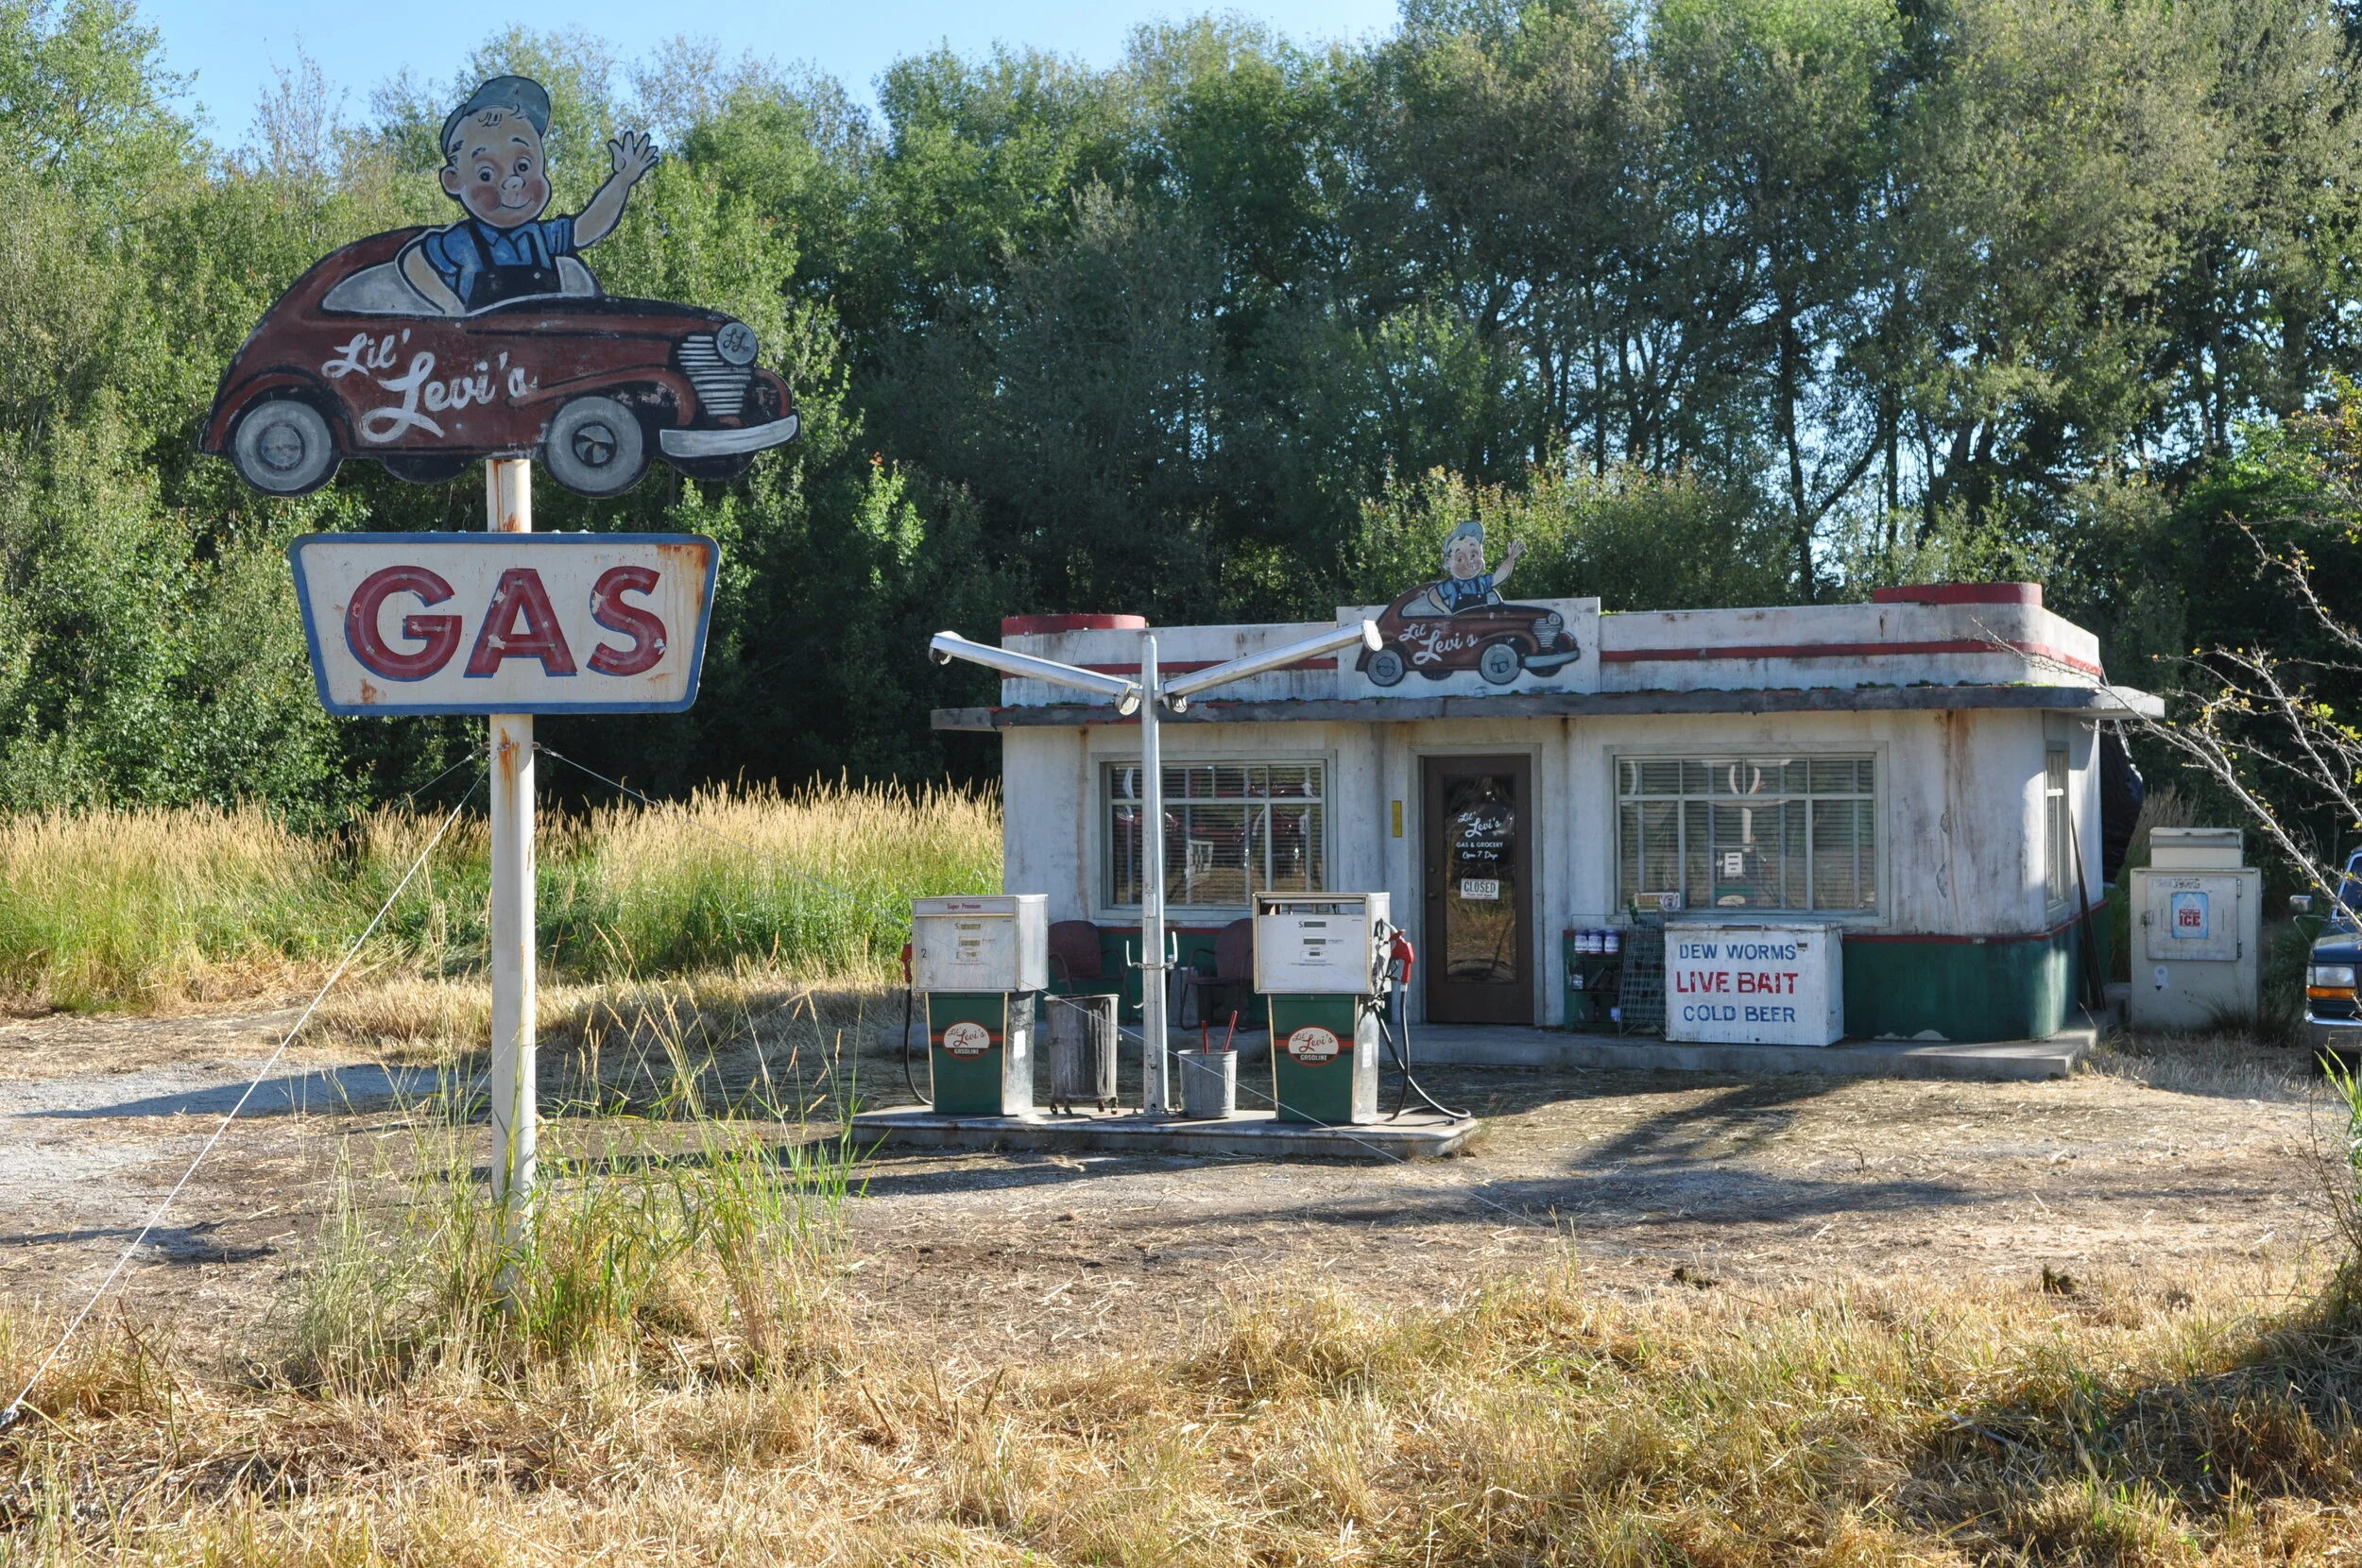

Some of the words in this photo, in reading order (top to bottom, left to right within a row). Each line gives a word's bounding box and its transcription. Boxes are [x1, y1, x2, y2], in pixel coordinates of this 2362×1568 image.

[321, 329, 411, 378] Lil'
[345, 566, 666, 682] GAS
[1412, 629, 1478, 665] Levis
[1465, 817, 1501, 838] Levi's
[1463, 880, 1496, 894] CLOSED
[2179, 915, 2200, 927] ICE
[920, 947, 927, 959] 2
[1680, 945, 1718, 960] DEW
[1726, 944, 1796, 961] WORMS
[1676, 971, 1731, 993] LIVE
[1737, 972, 1799, 994] BAIT
[1684, 1005, 1737, 1021] COLD
[1744, 1006, 1795, 1023] BEER
[953, 1029, 985, 1047] Levi's
[1299, 1033, 1334, 1052] Levi's
